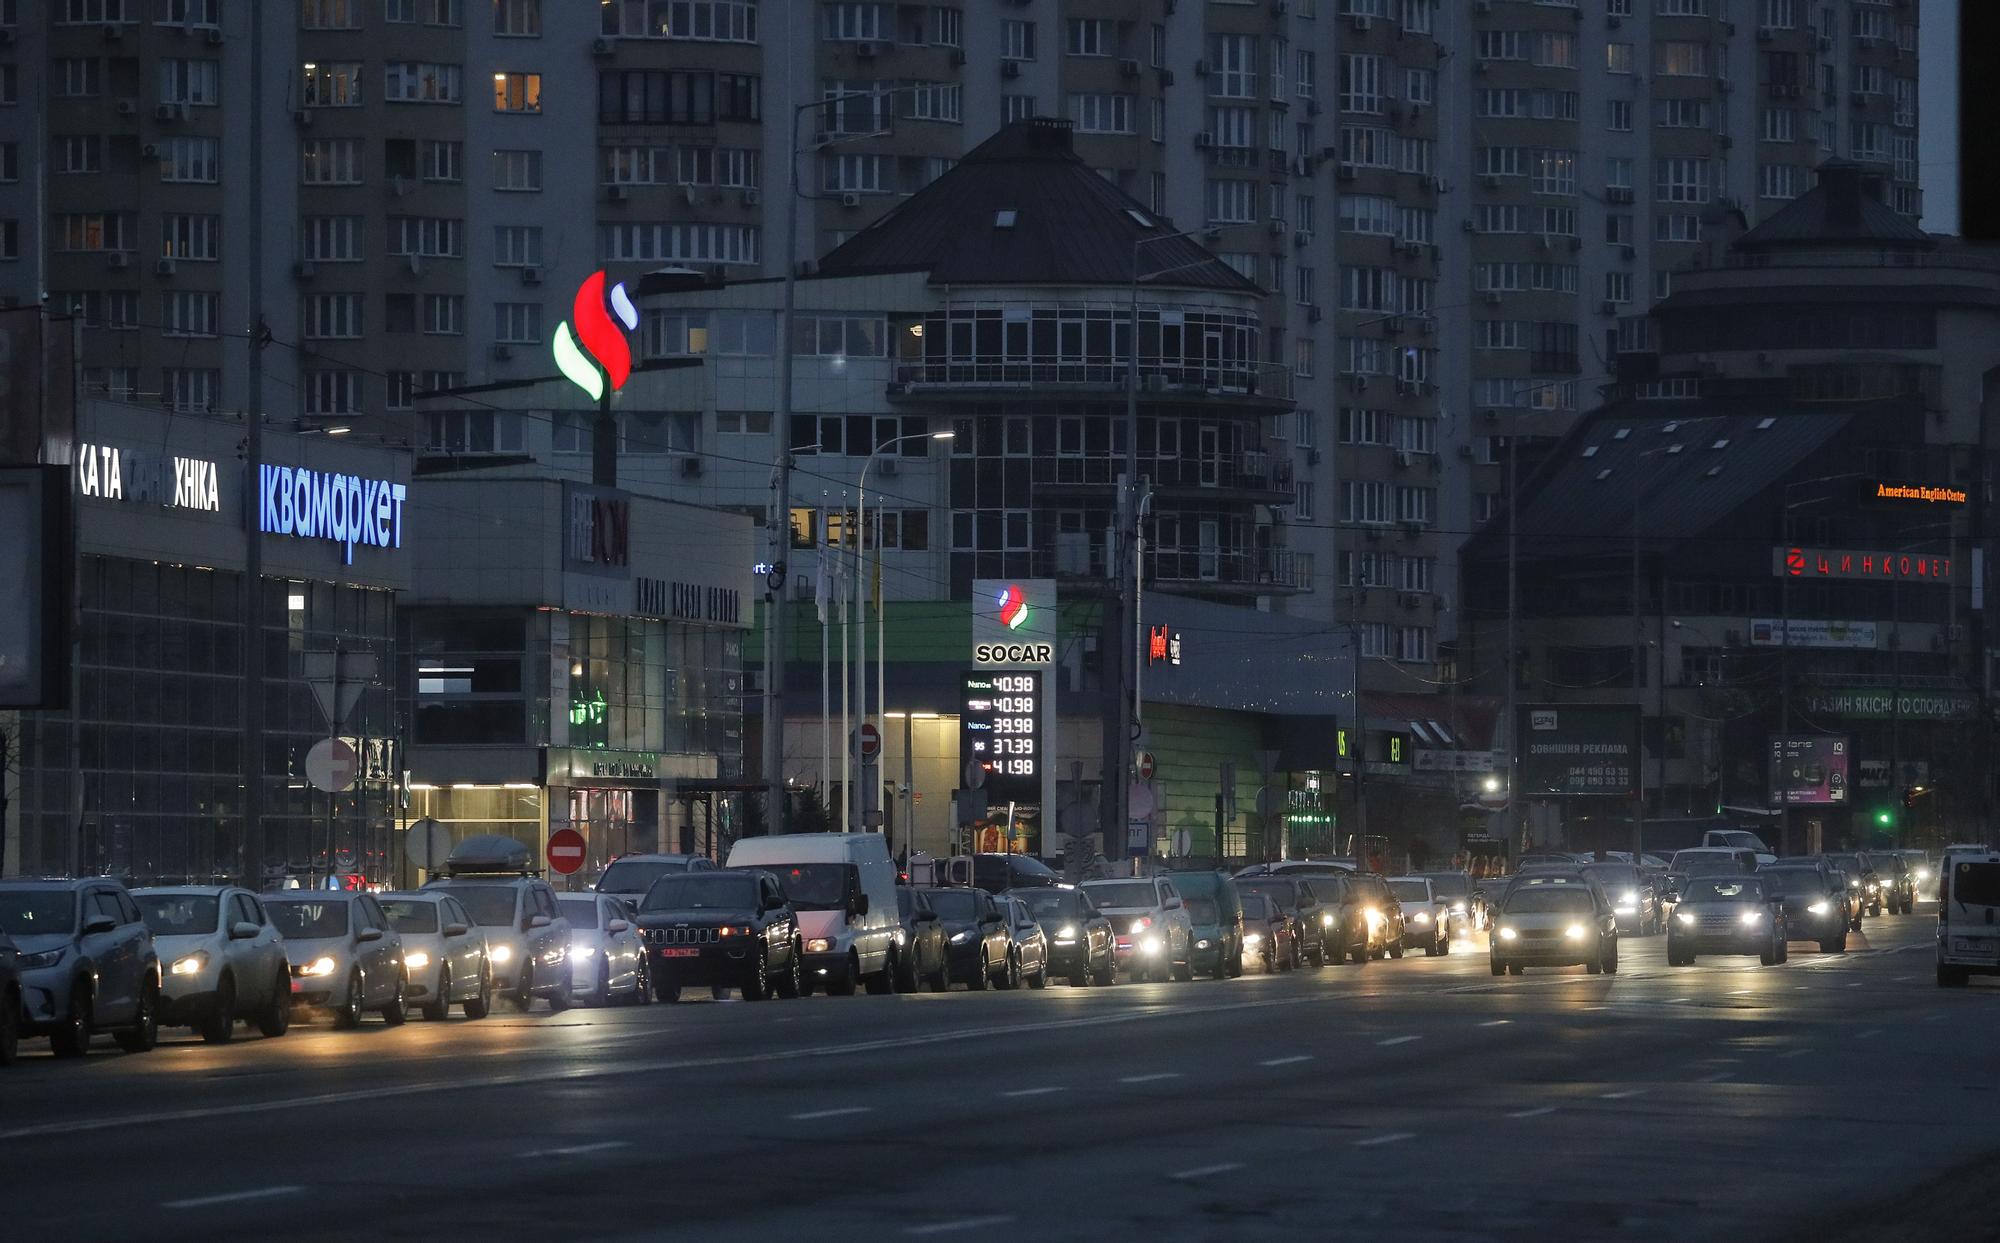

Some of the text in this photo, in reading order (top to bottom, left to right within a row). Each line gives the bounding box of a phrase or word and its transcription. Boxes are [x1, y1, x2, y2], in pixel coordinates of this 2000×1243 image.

[102, 446, 122, 500] ТА
[1877, 484, 1967, 504] American English Center
[1817, 554, 1951, 576] ЦИНКОМЕТ
[976, 645, 1051, 662] SOCAR
[993, 677, 1033, 692] 40.98
[993, 697, 1033, 713] 40.98
[994, 718, 1033, 734] 39.98
[974, 738, 1033, 754] 95 37.39
[1530, 743, 1628, 754] ЗОВНІШНЯ РЕКЛАМА
[993, 759, 1033, 775] 41.98
